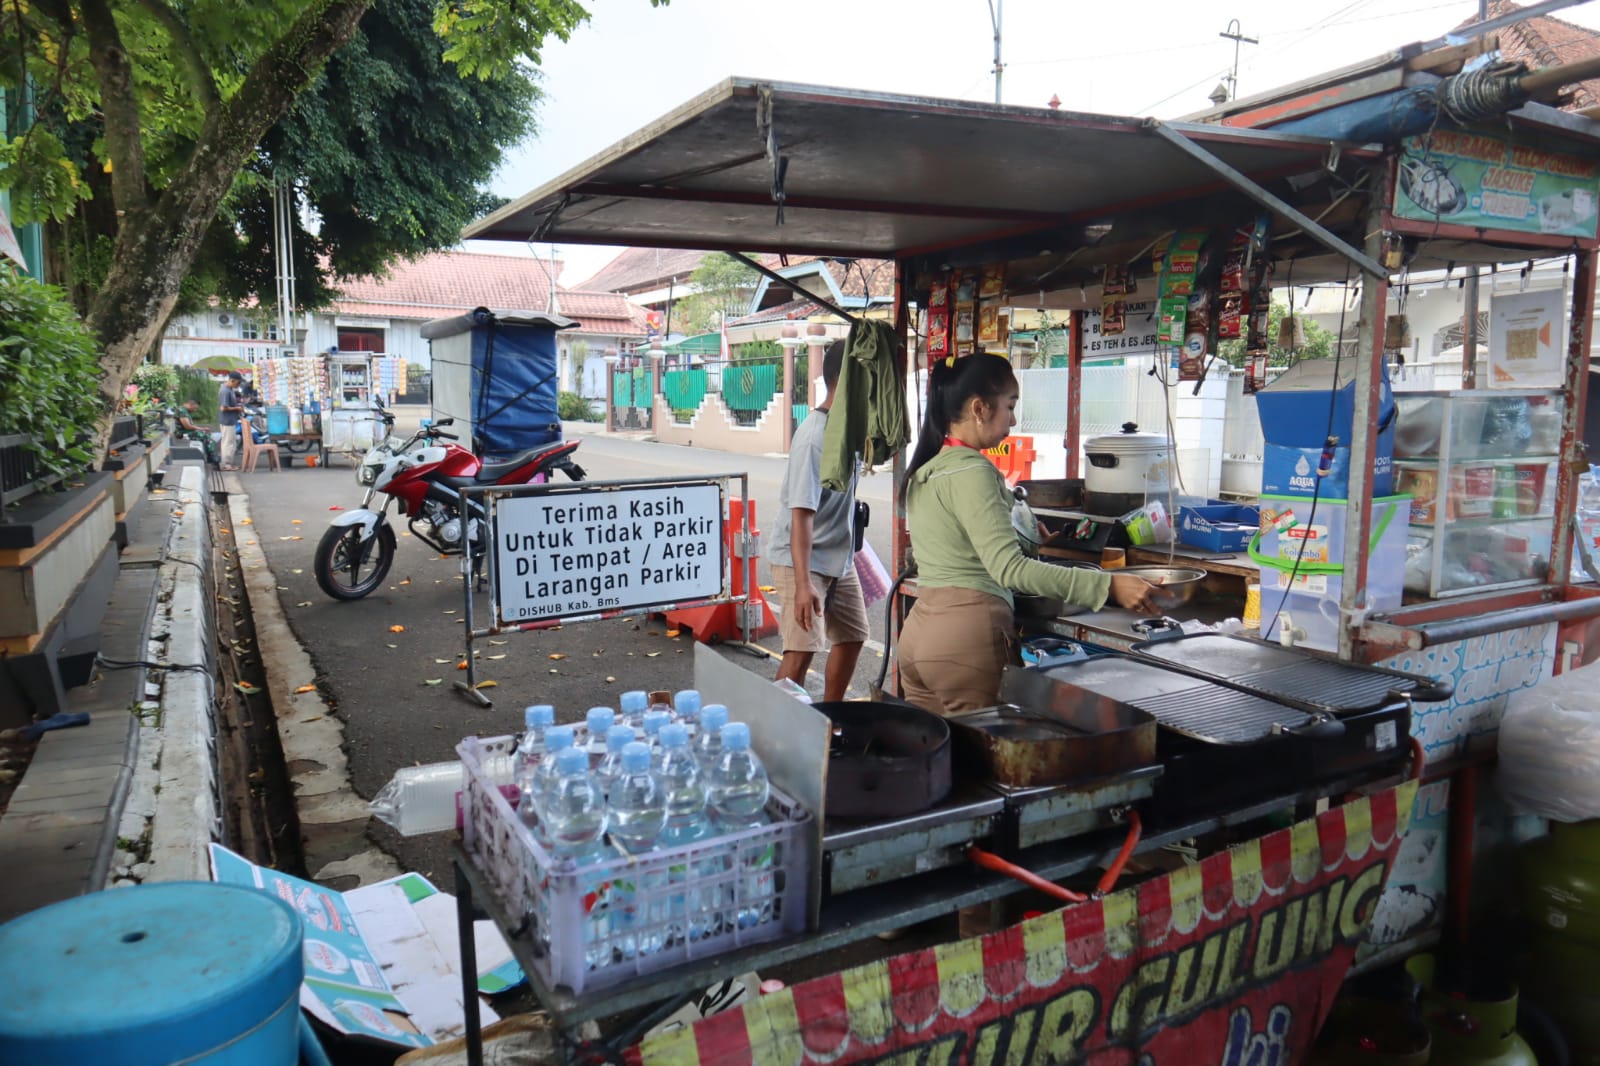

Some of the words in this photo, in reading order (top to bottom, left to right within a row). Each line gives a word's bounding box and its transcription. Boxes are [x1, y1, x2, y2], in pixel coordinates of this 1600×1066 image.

[1091, 341, 1101, 351] ES
[1103, 338, 1119, 350] TEH
[1128, 336, 1139, 347] ES
[1140, 334, 1158, 346] JER
[1289, 476, 1315, 488] AQUA
[542, 503, 617, 525] Terima
[630, 497, 684, 517] Kasih
[505, 528, 574, 552] Untuk
[585, 523, 642, 545] Tidak
[654, 516, 714, 539] Parkir
[516, 554, 538, 577] Di
[550, 546, 631, 572] Tempat
[641, 543, 651, 565] /
[662, 540, 707, 560] Area
[525, 572, 629, 600] Larangan
[641, 562, 701, 585] Parkir
[519, 605, 563, 617] DISHUB
[568, 600, 593, 611] Kab.
[597, 596, 620, 608] Bms
[1110, 861, 1387, 1039] GULUNG
